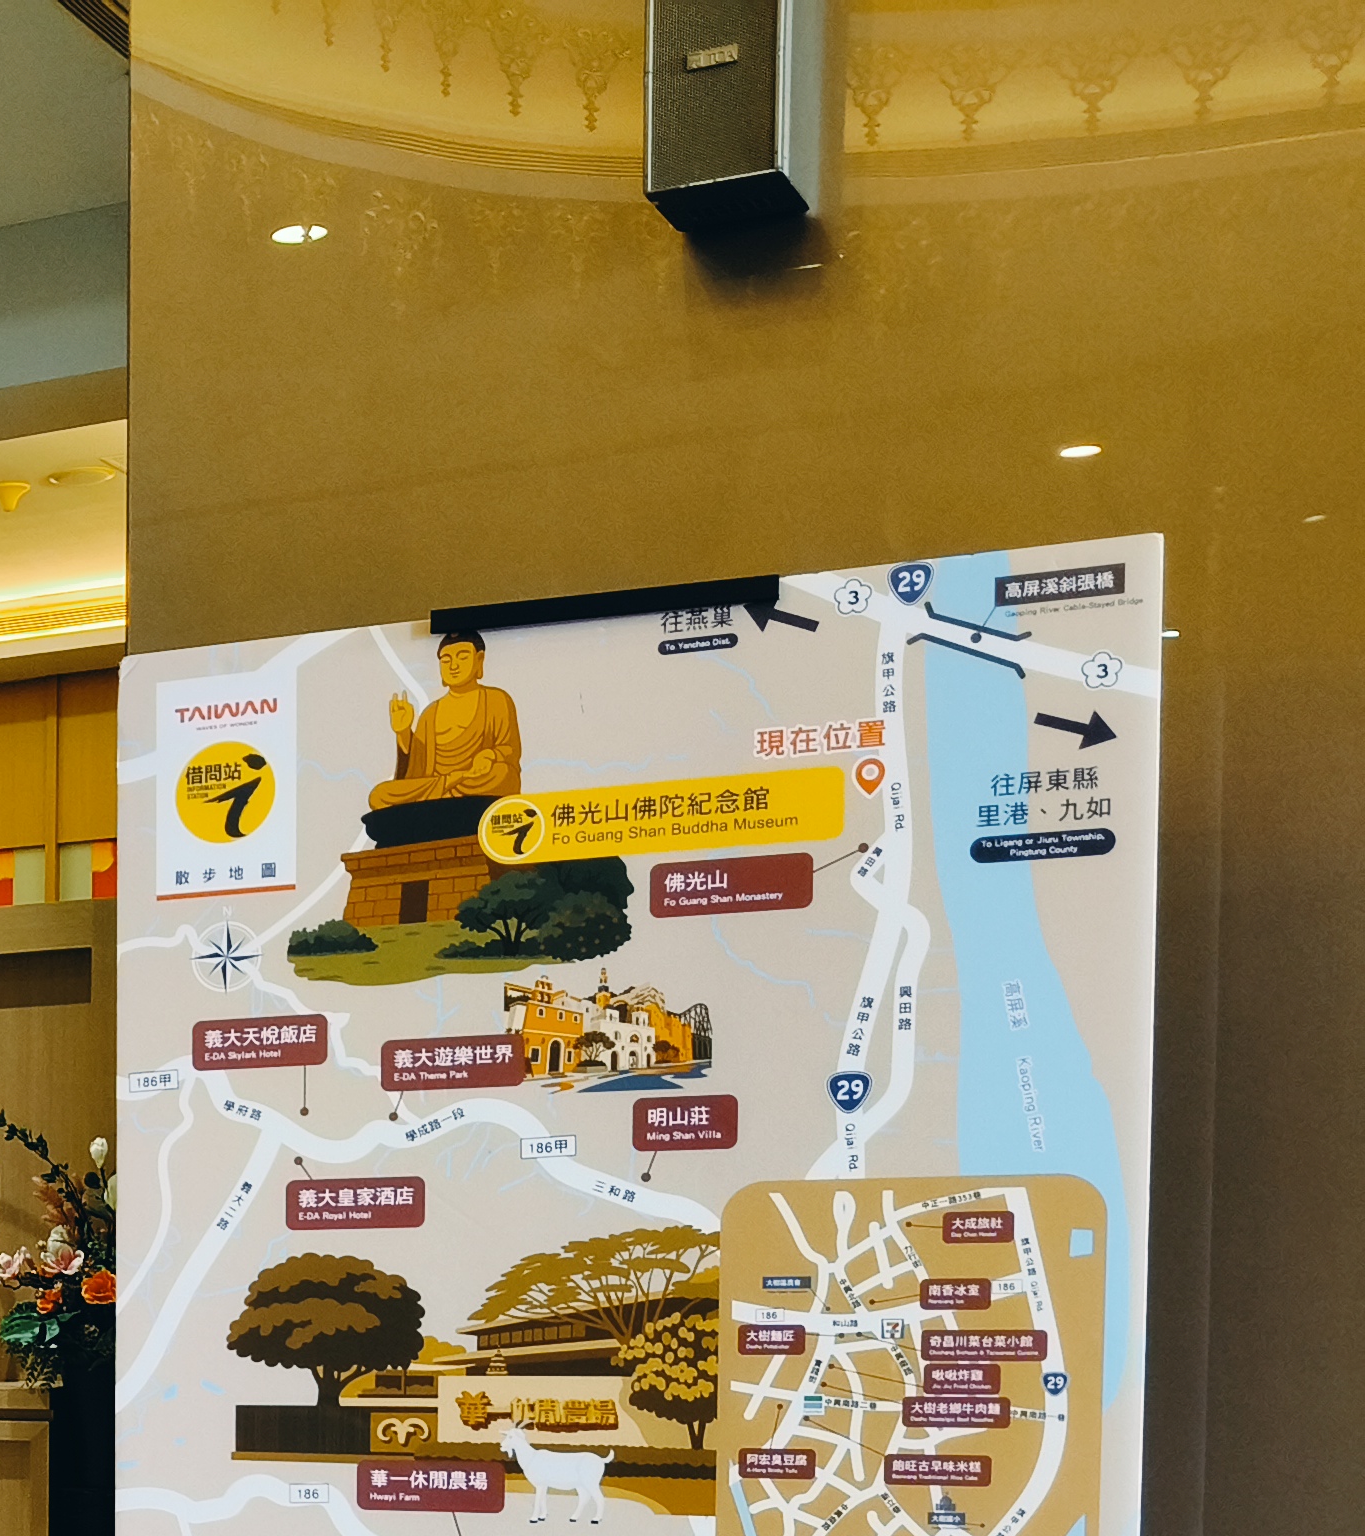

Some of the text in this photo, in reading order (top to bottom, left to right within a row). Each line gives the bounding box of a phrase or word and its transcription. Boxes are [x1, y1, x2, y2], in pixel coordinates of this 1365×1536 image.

[897, 570, 925, 593] 29
[1004, 571, 1115, 599] 高屏溪斜張橋
[848, 591, 859, 606] 3
[660, 606, 734, 634] 往燕巢
[1096, 663, 1109, 678] 3
[881, 651, 897, 714] 旗甲公路
[175, 698, 278, 723] TAIWAN
[755, 719, 886, 757] 現在位置
[185, 762, 241, 785] 借問站
[990, 766, 1099, 797] 往屏東縣
[551, 786, 770, 827] 佛光山佛陀紀念館
[976, 796, 1111, 827] 里港、九如
[490, 813, 523, 826] 借問站
[552, 814, 799, 845] Fo Guang Shan Buddha Museum
[1048, 845, 1078, 855] County
[175, 862, 276, 886] 散步地圖
[663, 869, 728, 893] 佛光山
[663, 890, 783, 907] Fo Guang Shan Monastery
[898, 985, 912, 1031] 興田路
[204, 1024, 317, 1048] 義大天悅飯店
[846, 996, 874, 1057] 旗甲公路
[204, 1052, 225, 1061] E-DA
[393, 1044, 514, 1069] 義大遊樂世界
[136, 1073, 172, 1089] 186甲
[393, 1070, 469, 1082] E-DA Theme Park
[837, 1079, 864, 1100] 29
[1018, 1057, 1045, 1151] Kaoping River
[646, 1105, 710, 1127] 明山莊
[529, 1139, 568, 1154] 186甲
[646, 1130, 721, 1142] Ming Shan Villa
[298, 1186, 415, 1209] 義大皇家酒店
[592, 1179, 637, 1203] 三和路
[298, 1210, 372, 1221] E-DA Royal Hotel
[952, 1217, 1003, 1229] 大成旅社
[928, 1284, 980, 1296] 南香冰室
[998, 1283, 1015, 1291] 186
[1047, 1376, 1064, 1389] 29
[746, 1453, 807, 1466] 阿宏臭豆腐
[370, 1468, 488, 1491] 華一休閒農場
[297, 1487, 319, 1500] 186
[399, 1493, 420, 1501] Farm
